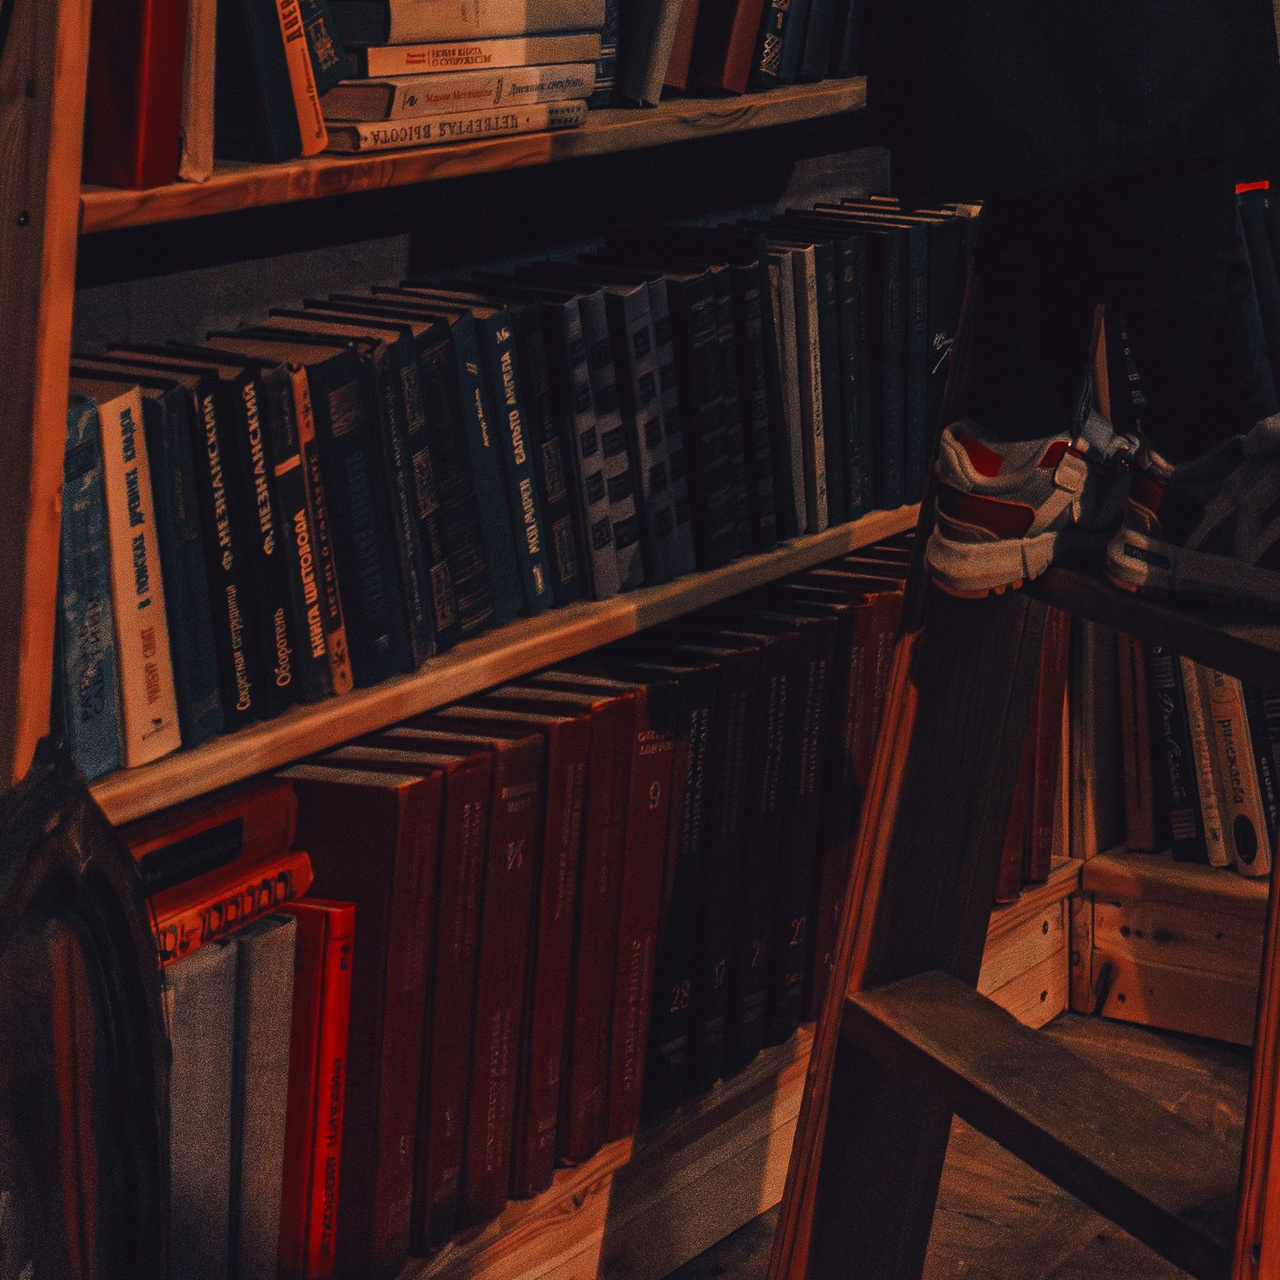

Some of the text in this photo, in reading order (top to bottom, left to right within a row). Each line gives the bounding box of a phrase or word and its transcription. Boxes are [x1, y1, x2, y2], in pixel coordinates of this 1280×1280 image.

[371, 123, 433, 144] ВЫСОТА
[438, 112, 518, 134] ЧЕТВЕРТАЯ
[125, 467, 146, 526] ДРЕВНИХ
[133, 532, 151, 594] ПОИСКАХ
[200, 395, 253, 711] Секретная сотрудница Ф.НЕЗНАНСКИЙ
[240, 379, 297, 687] Оборотень Ф.НЕЗНАНСКИЙ
[292, 508, 327, 658] КНИГА ЦВЕТОВОДА
[141, 626, 161, 704] УИЛБУР СМИТ
